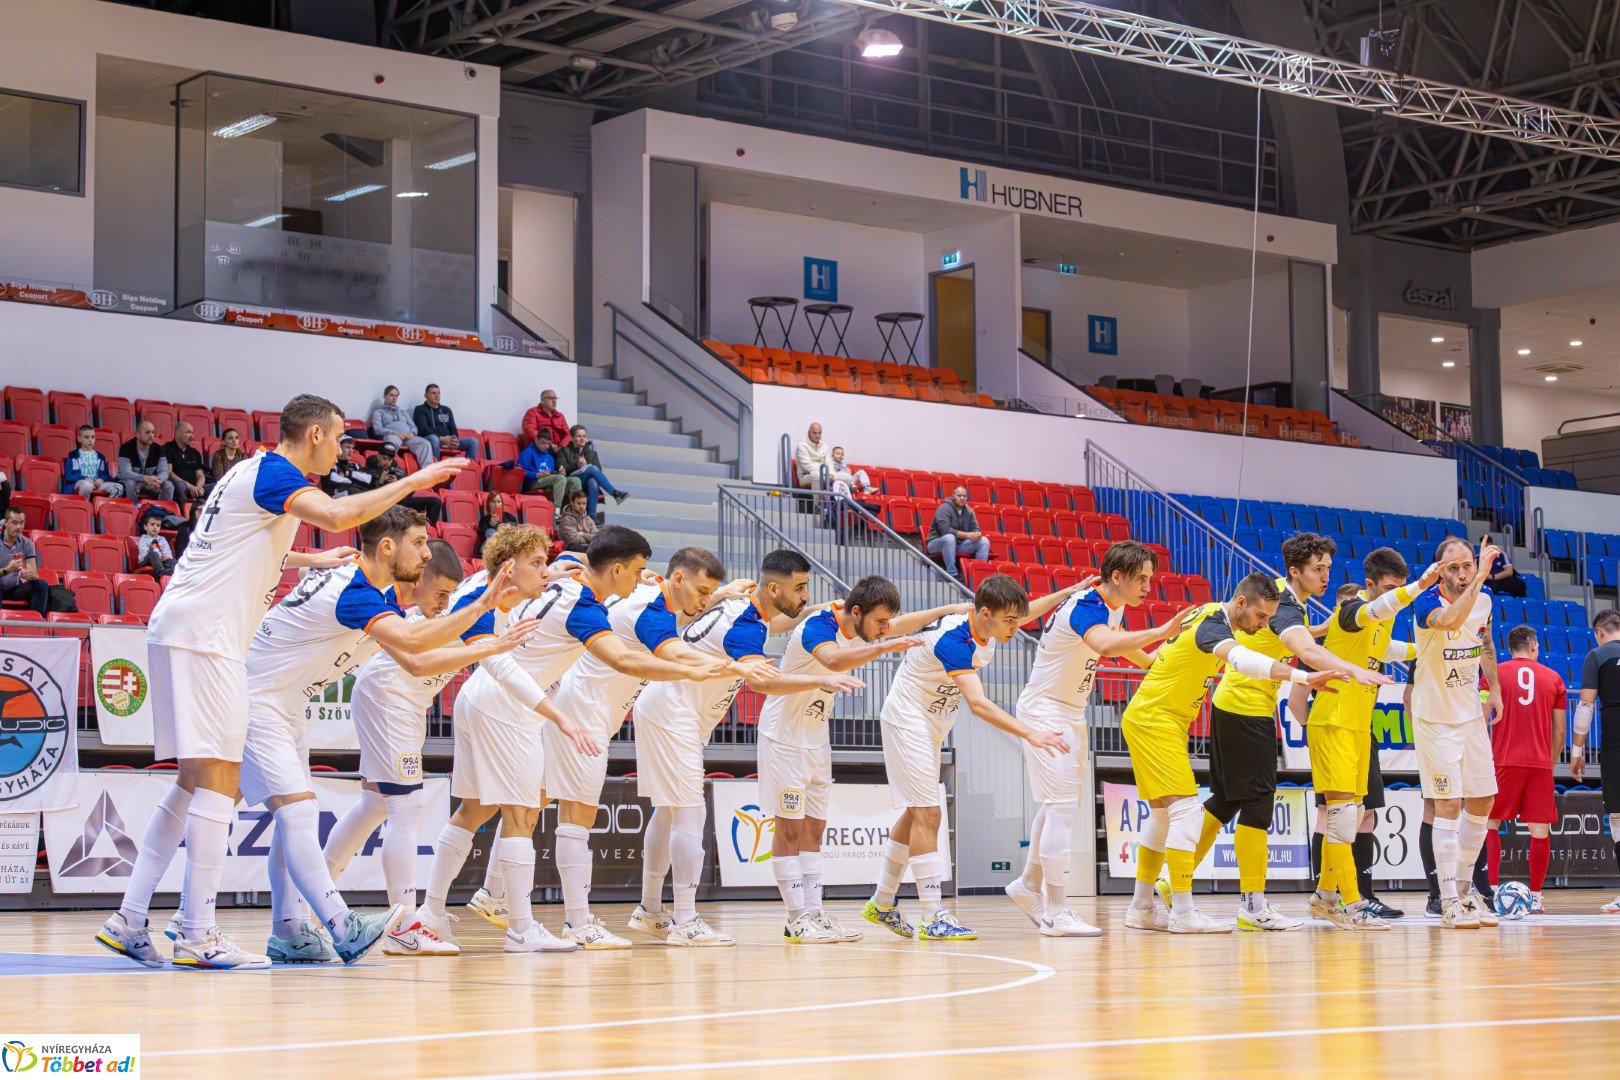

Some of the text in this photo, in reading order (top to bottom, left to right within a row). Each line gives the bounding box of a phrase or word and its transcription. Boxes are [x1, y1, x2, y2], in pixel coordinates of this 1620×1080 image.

[992, 183, 1083, 218] HÜBNER
[92, 292, 112, 306] BH
[122, 293, 167, 306] Bige Holding
[130, 304, 158, 312] Csoport
[200, 305, 220, 317] BH
[236, 315, 263, 324] Csoport
[303, 316, 322, 329] BH
[337, 326, 364, 335] Csoport
[402, 327, 420, 340] BH
[435, 337, 461, 346] Csoport
[496, 339, 513, 351] BH
[1517, 666, 1535, 706] 9
[783, 793, 799, 801] 99.4
[1, 841, 30, 850] ÉS KÁVÉ
[842, 849, 866, 859] VÁROS
[5, 875, 17, 884] ÚT
